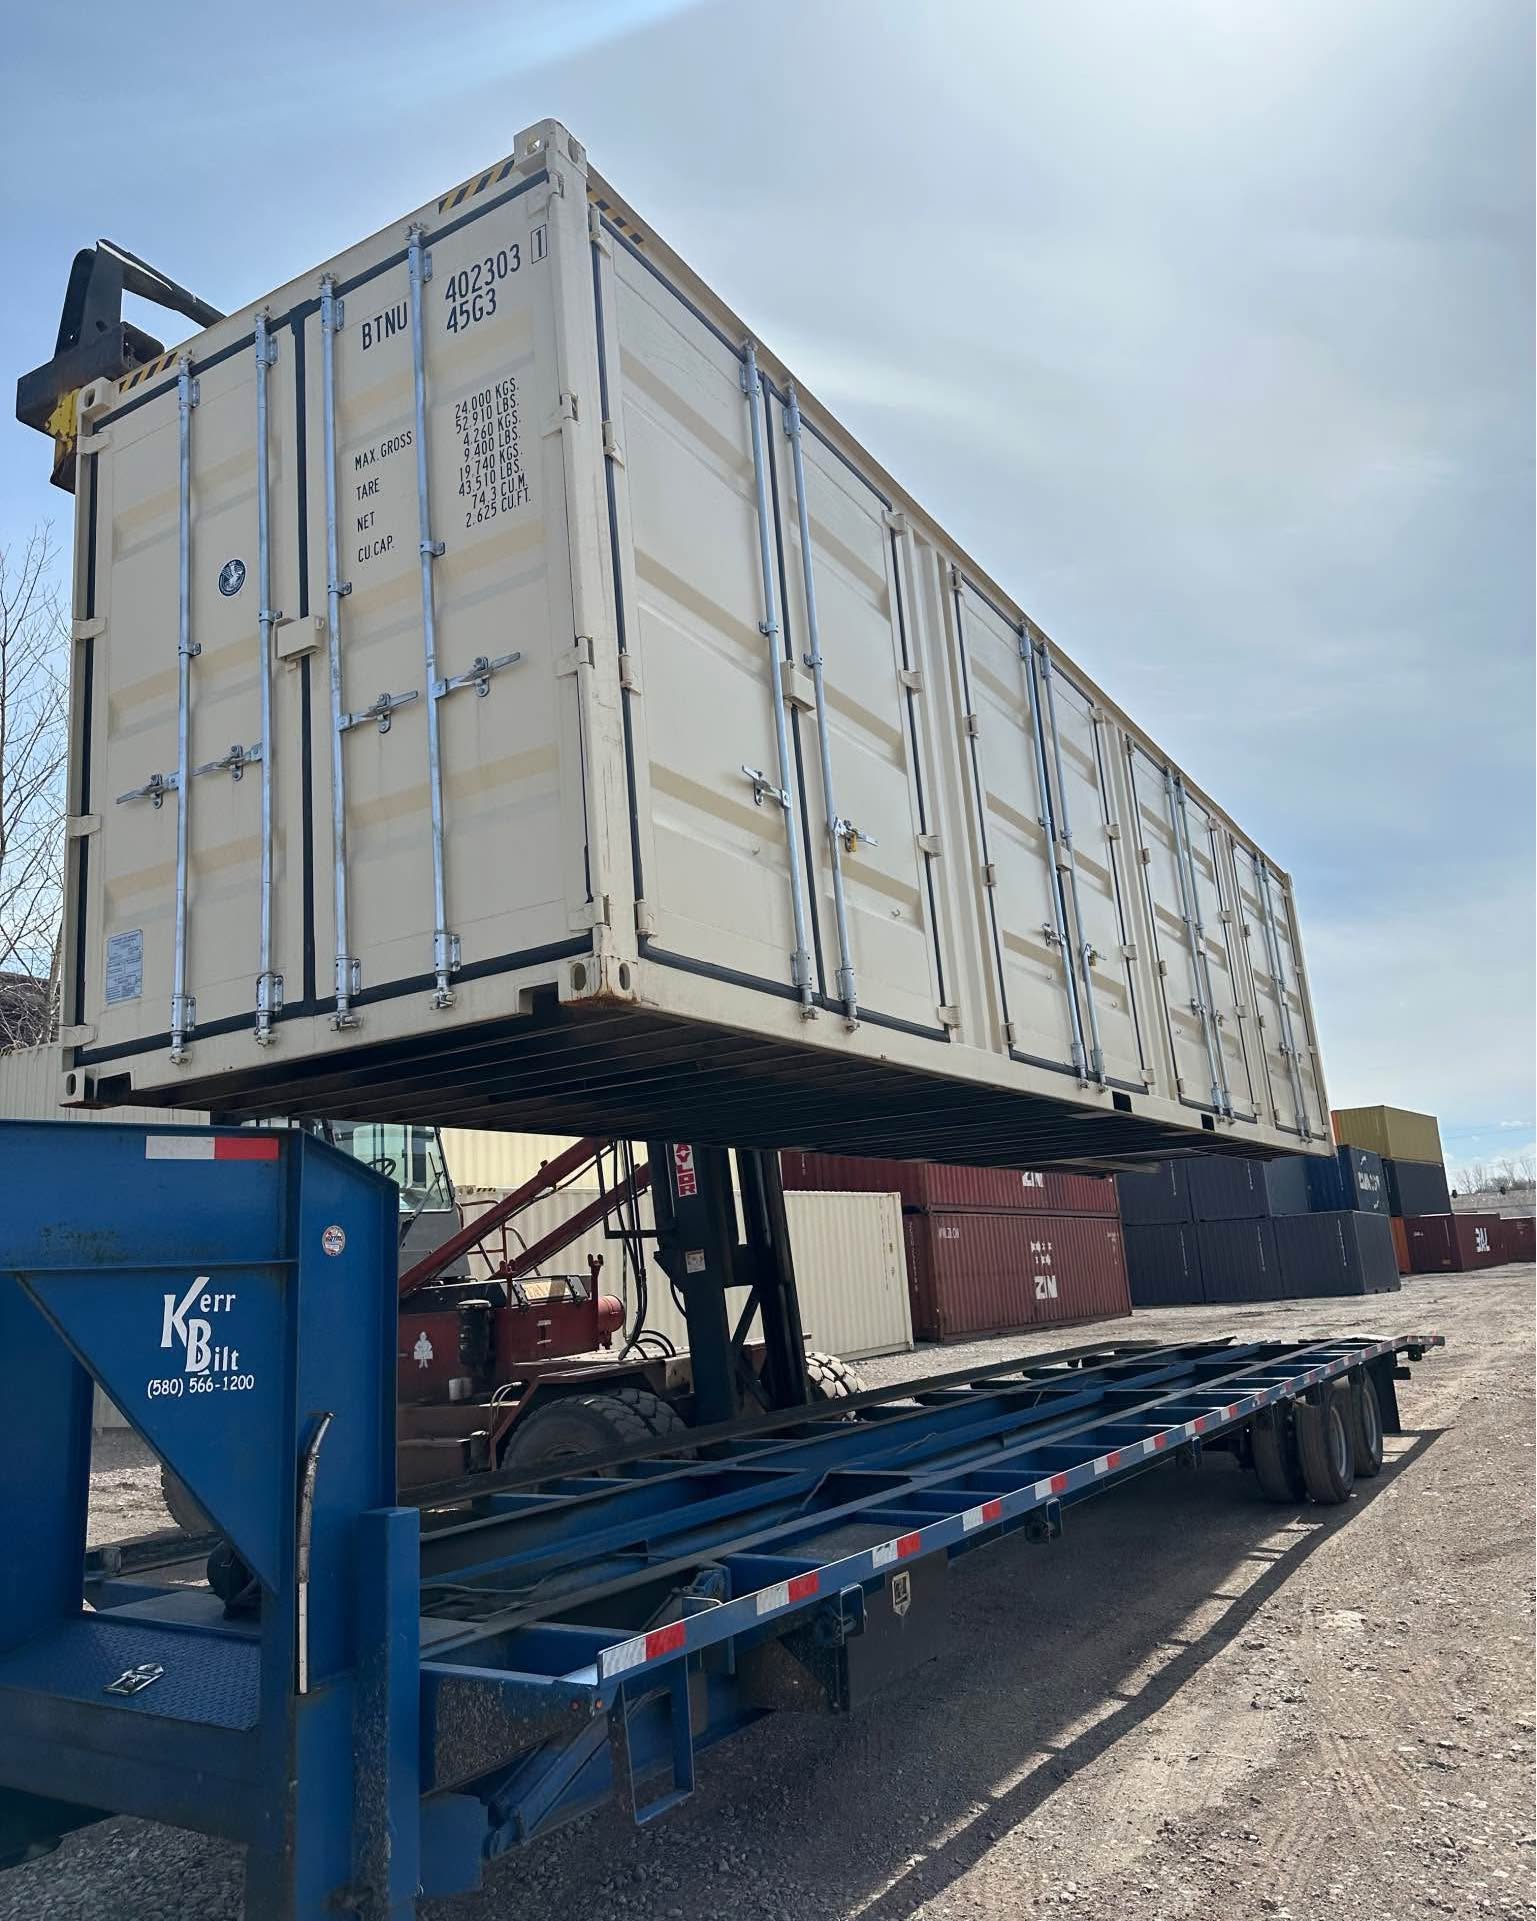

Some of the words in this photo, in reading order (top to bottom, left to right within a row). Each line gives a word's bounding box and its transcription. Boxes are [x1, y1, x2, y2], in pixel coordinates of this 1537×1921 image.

[361, 302, 408, 350] BTNU
[445, 243, 521, 303] 402303
[446, 287, 497, 334] 45G3
[455, 389, 491, 419] 24.000
[495, 377, 520, 400] KGS.
[455, 404, 493, 434] 52.910
[496, 393, 520, 415] LBS.
[356, 477, 380, 501] TARE
[463, 421, 494, 447] 4.260
[497, 409, 522, 433] KGS.
[464, 436, 495, 463] 9.400
[498, 425, 521, 448] LBS.
[356, 511, 375, 533] NET
[459, 453, 496, 482] 19.740
[499, 442, 524, 465] KGS.
[458, 469, 496, 497] 43.510
[500, 458, 523, 480] LBS.
[471, 486, 497, 509] 74.3
[465, 501, 497, 528] 2.625
[160, 1276, 236, 1348] Kerr
[184, 1318, 239, 1376] Bilt
[147, 1378, 184, 1399] (580)
[189, 1375, 255, 1394] 566-1200
